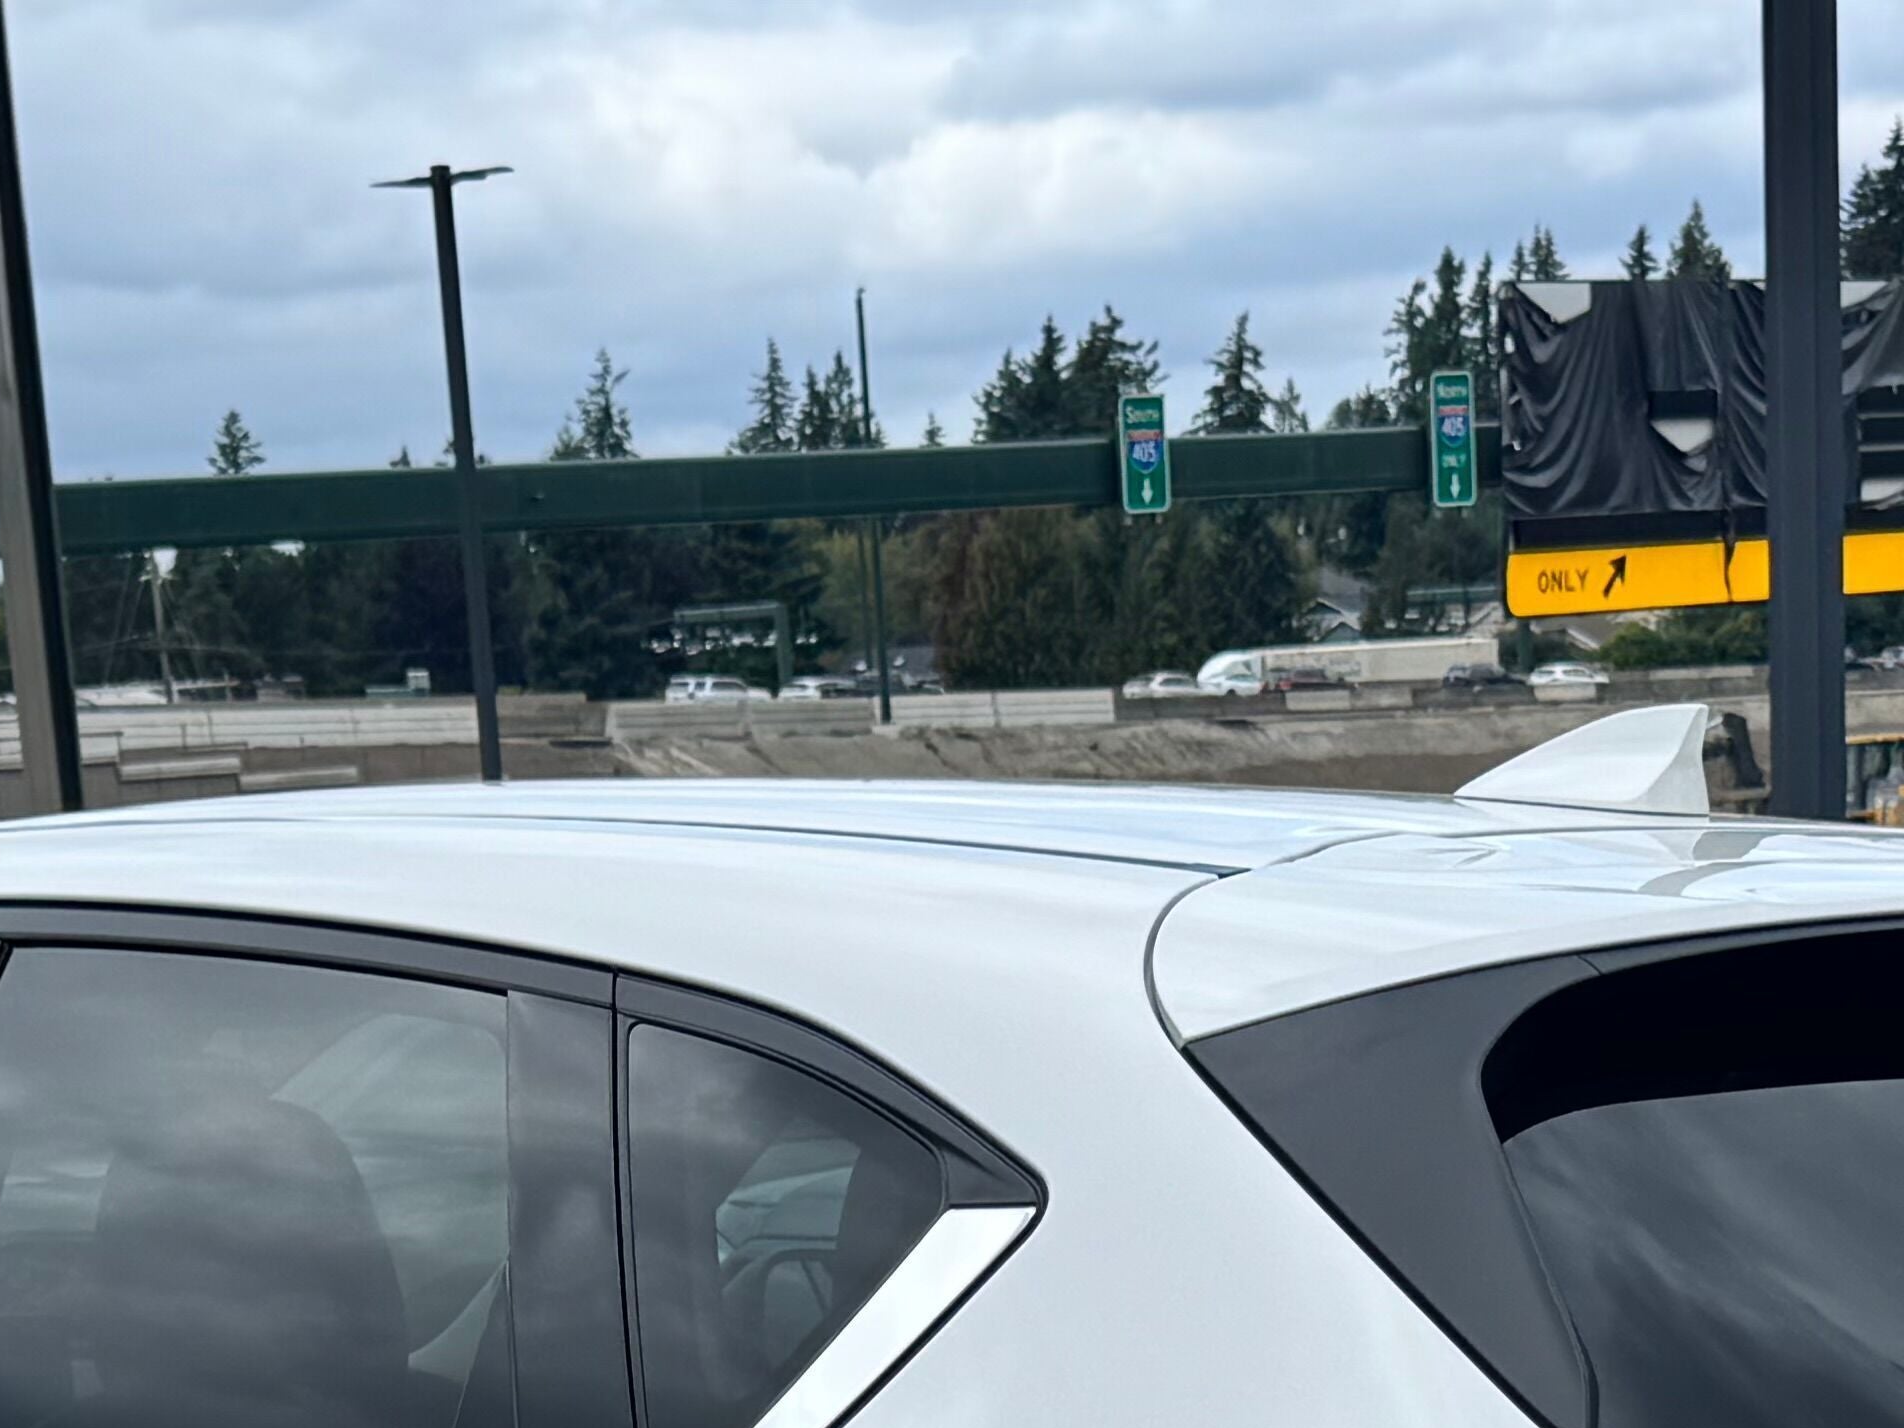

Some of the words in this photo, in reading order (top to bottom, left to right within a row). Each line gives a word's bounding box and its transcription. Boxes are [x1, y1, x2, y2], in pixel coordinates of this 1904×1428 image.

[1441, 416, 1465, 437] 405
[1131, 440, 1157, 463] 405
[1536, 567, 1590, 595] ONLY
